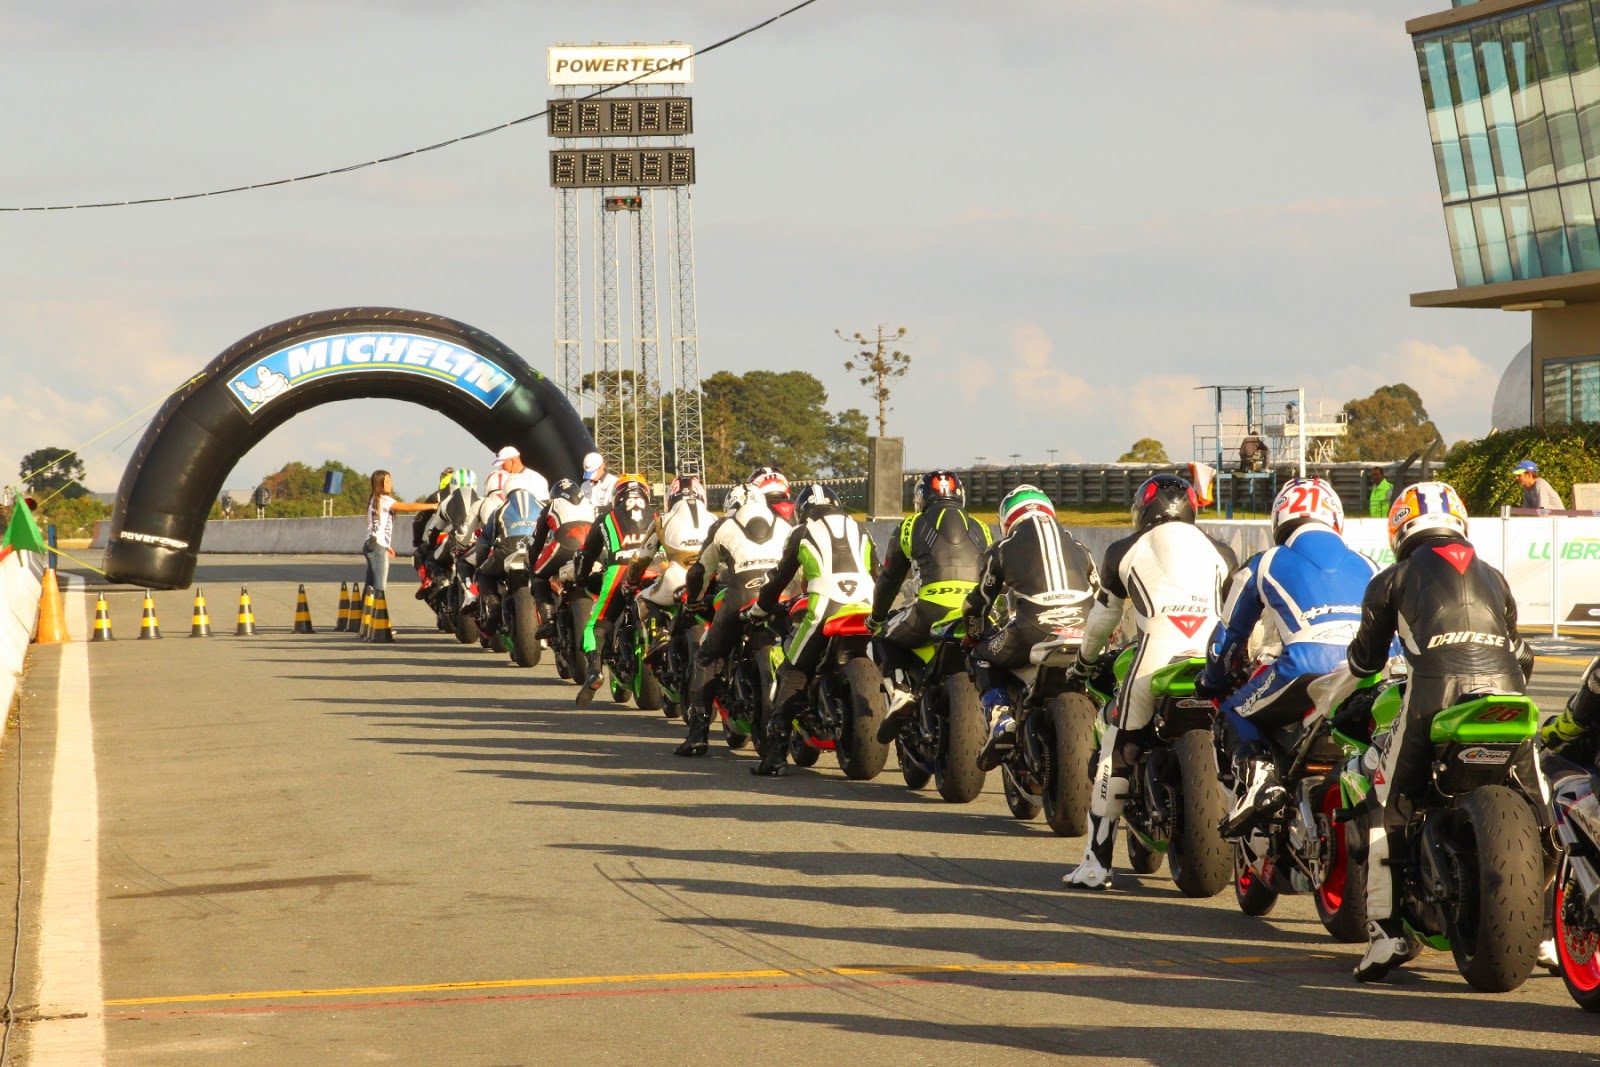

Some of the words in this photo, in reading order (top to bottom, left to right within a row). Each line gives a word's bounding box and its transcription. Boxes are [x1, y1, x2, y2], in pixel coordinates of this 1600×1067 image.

[556, 58, 684, 73] POWERTECH
[287, 336, 508, 393] MICHELIN
[1289, 487, 1320, 514] 21
[1528, 542, 1600, 560] LUBR
[1160, 604, 1210, 614] DAINESE
[1427, 631, 1506, 649] DAINESE
[1477, 705, 1525, 722] 26
